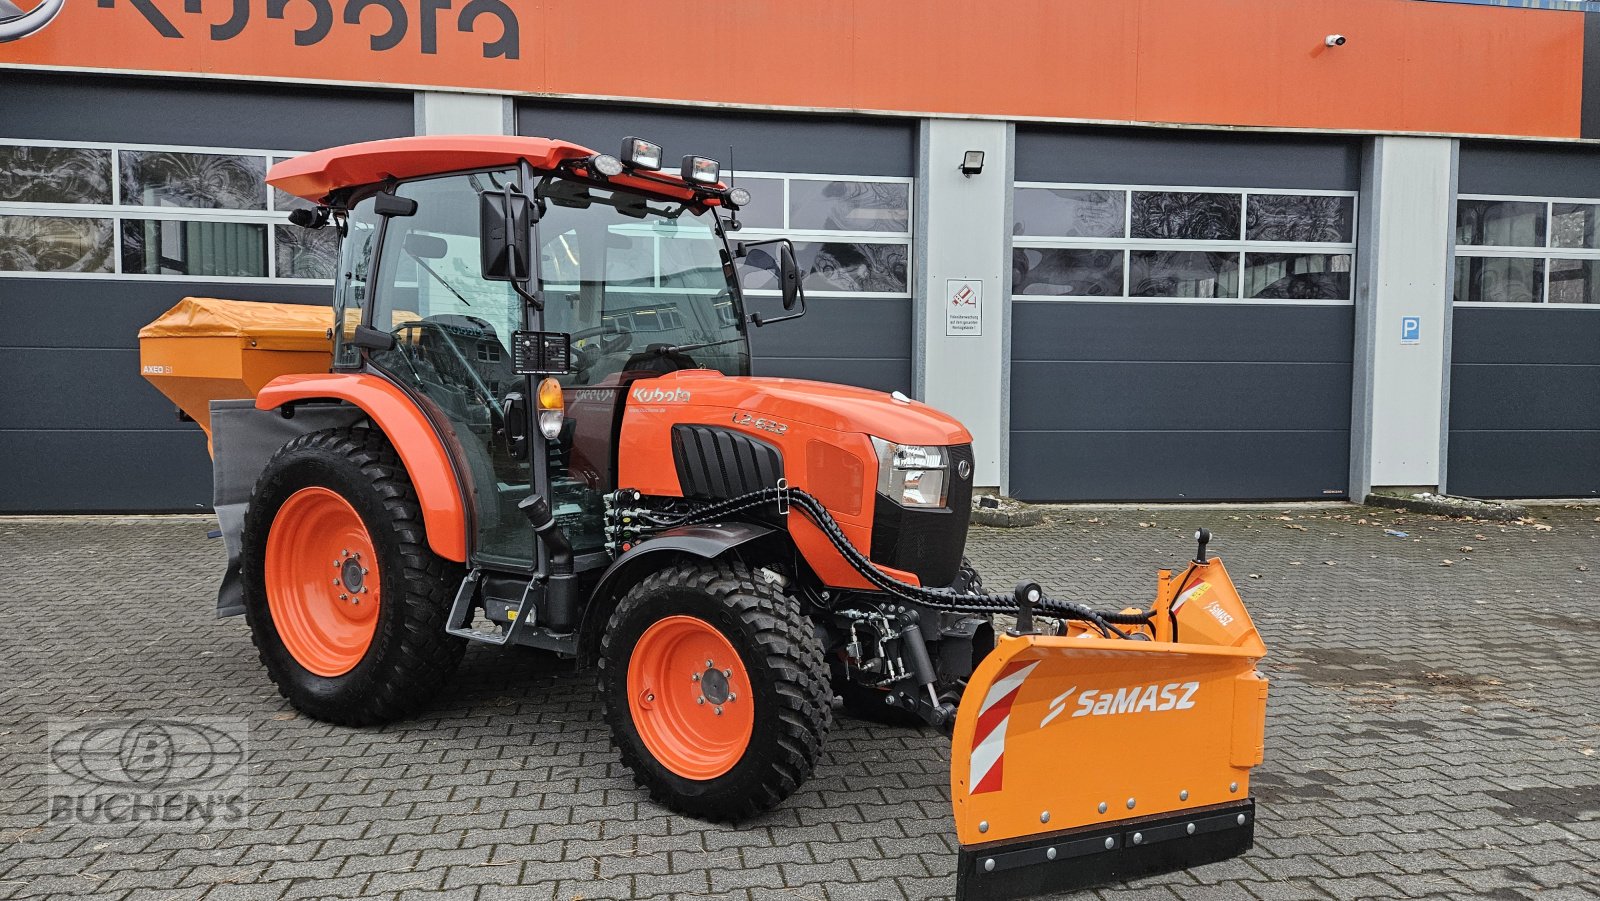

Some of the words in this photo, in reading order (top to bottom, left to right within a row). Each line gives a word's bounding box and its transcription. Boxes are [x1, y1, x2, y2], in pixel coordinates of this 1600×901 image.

[1404, 319, 1418, 338] P
[143, 365, 164, 374] AXEO
[632, 387, 691, 403] Kubota
[1208, 602, 1234, 627] SaMASZ
[1071, 681, 1200, 718] SaMASZ
